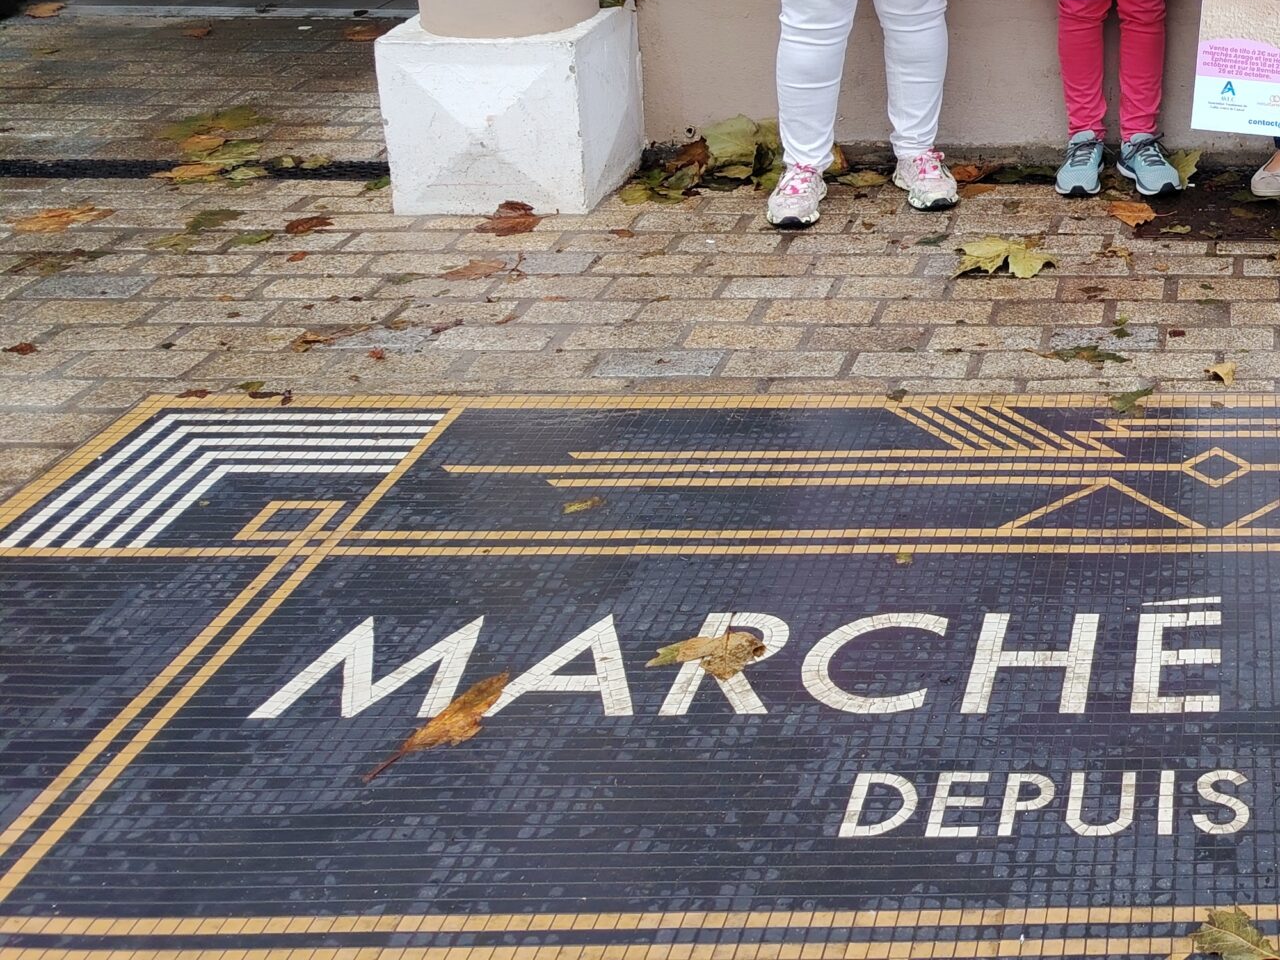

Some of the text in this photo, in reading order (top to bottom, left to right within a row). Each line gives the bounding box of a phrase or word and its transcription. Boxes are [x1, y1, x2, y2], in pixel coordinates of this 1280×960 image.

[1209, 44, 1228, 53] Vente
[1233, 54, 1253, 62] Arago
[247, 596, 1223, 719] MARCHÉ
[838, 769, 1252, 838] DEPUIS
